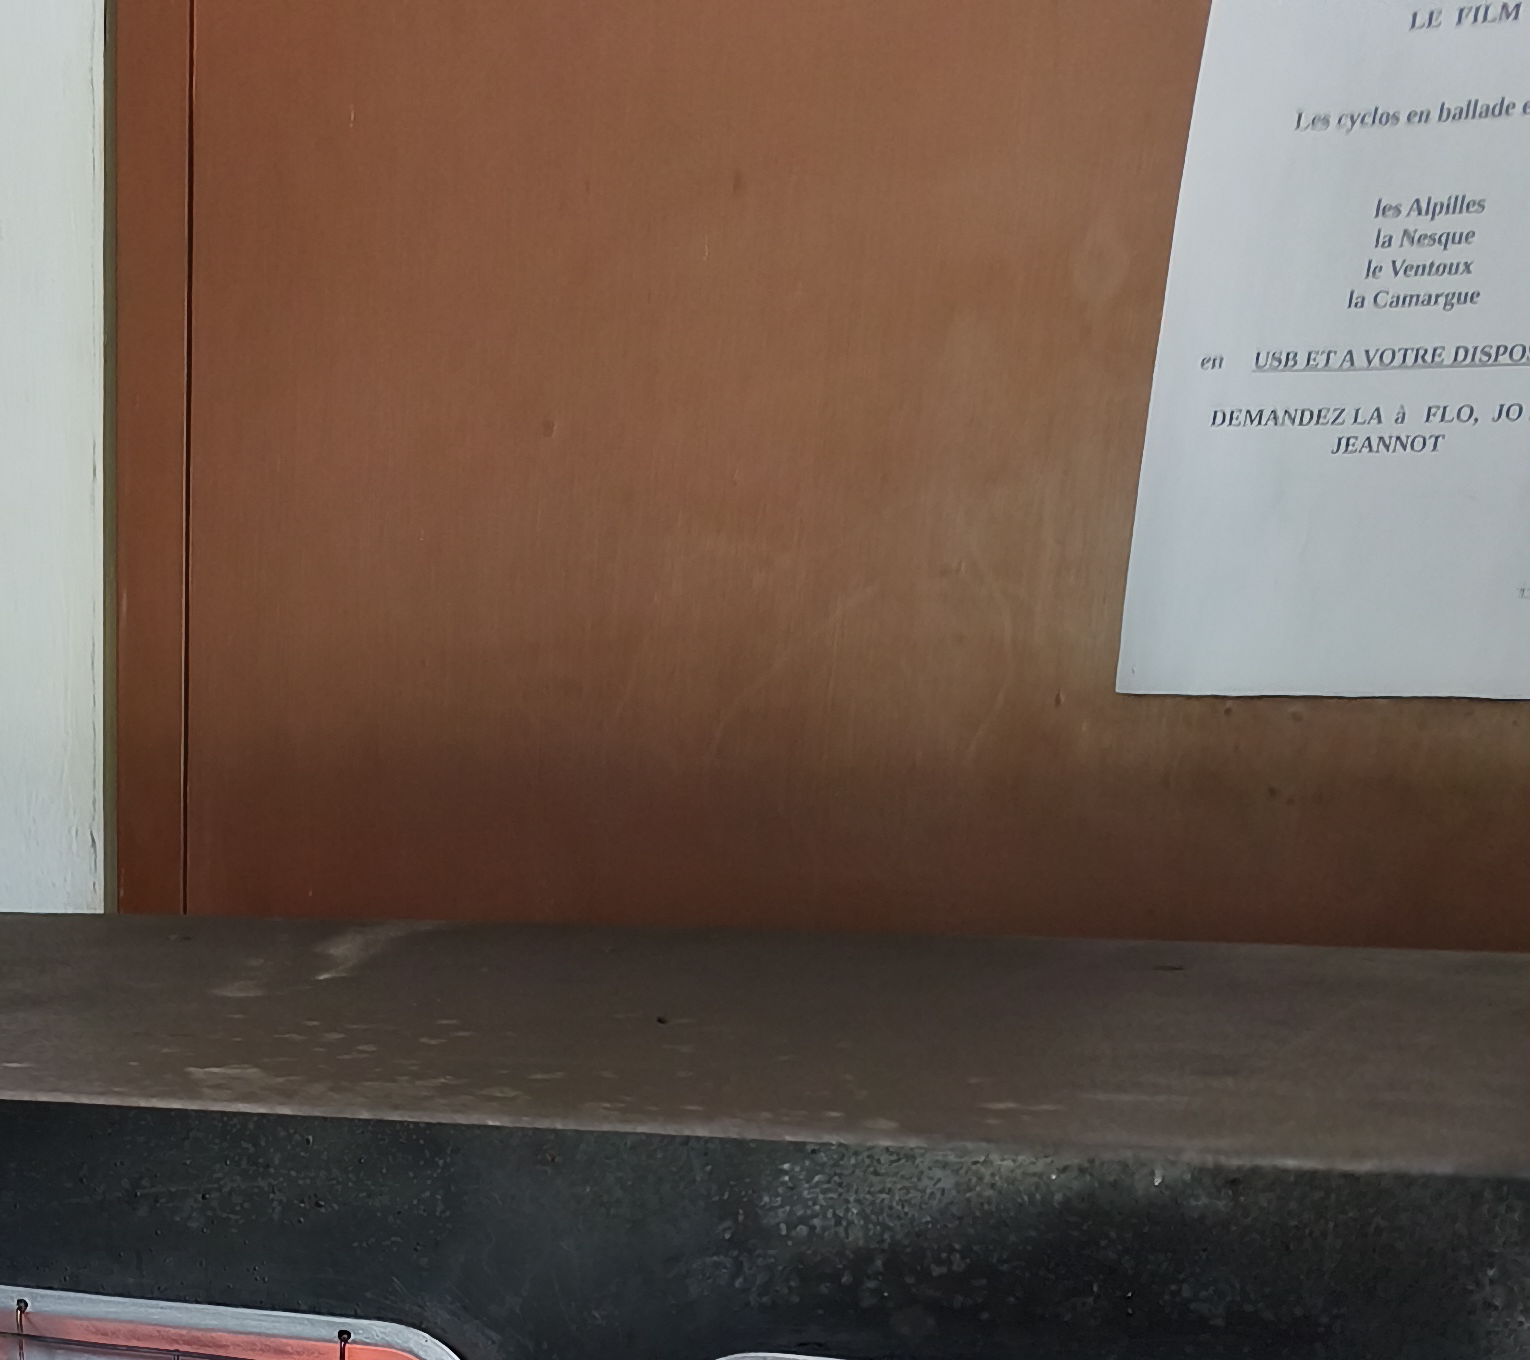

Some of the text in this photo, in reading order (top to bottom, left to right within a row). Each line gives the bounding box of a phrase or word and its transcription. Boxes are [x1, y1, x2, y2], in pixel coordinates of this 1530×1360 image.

[1409, 1, 1522, 31] LE FILM
[1294, 110, 1331, 131] Les
[1337, 106, 1401, 134] cyclos
[1406, 108, 1431, 124] en
[1437, 97, 1517, 123] ballade
[1374, 194, 1486, 222] les Alpilles
[1374, 228, 1476, 251] la Nesque
[1365, 258, 1475, 280] le Ventoux
[1347, 288, 1481, 312] la Camargue
[1200, 343, 1530, 370] en USB ET A VOTRE DISPO
[1210, 402, 1524, 427] DEMANDEZ LA à FLO, JO
[1330, 433, 1446, 455] JEANNOT
